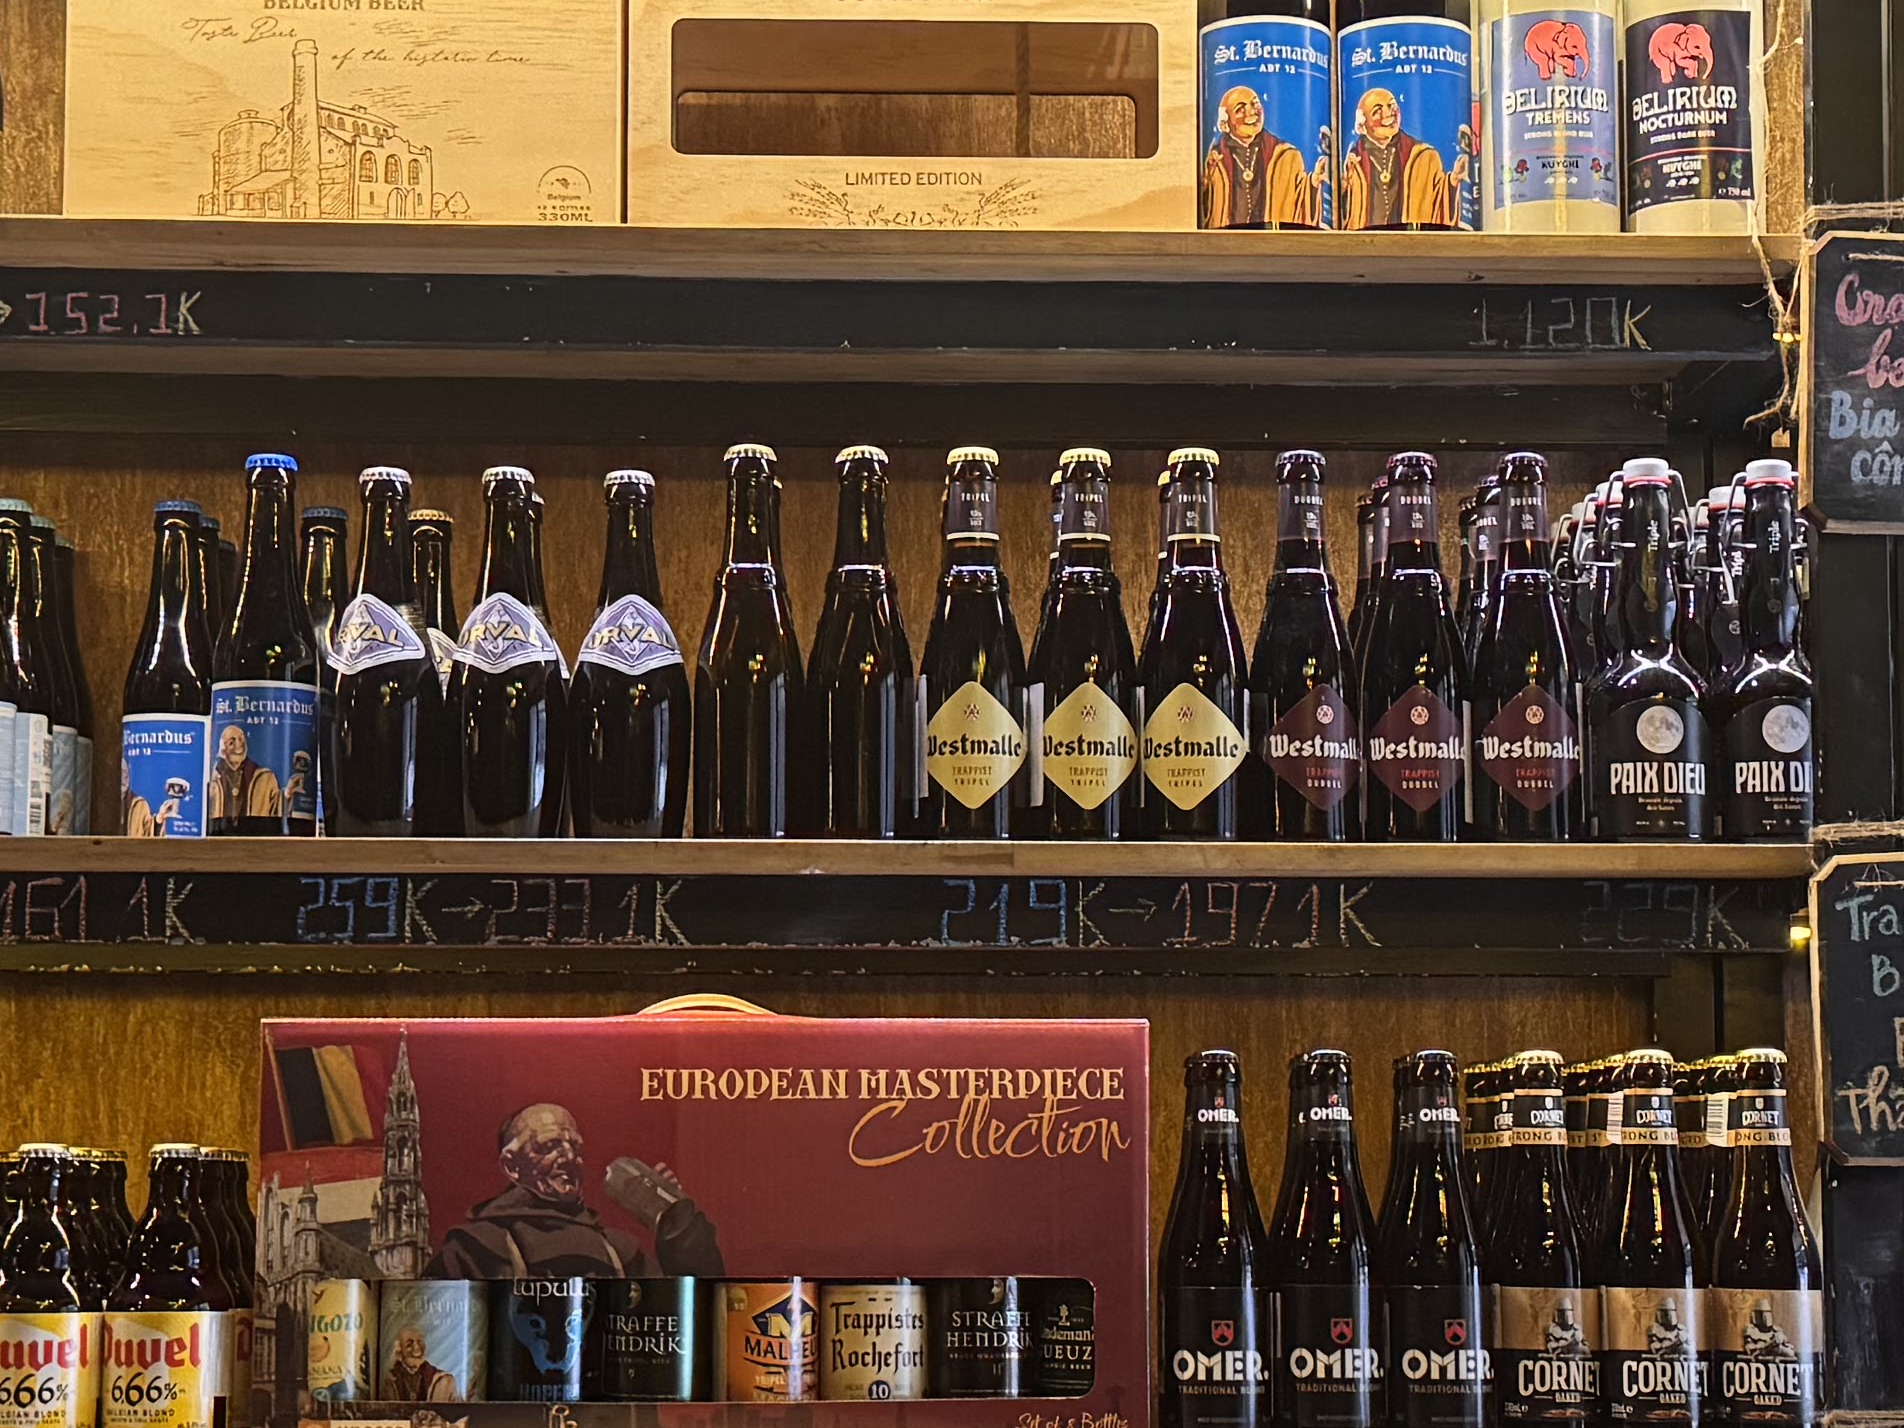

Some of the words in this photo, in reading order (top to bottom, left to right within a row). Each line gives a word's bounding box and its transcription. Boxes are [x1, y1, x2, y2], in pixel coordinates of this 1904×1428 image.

[1503, 86, 1608, 116] DELIRIUM
[1632, 85, 1737, 116] DELIRIUM
[1526, 111, 1591, 127] TREMENS
[1640, 110, 1727, 134] NOCTURNUM
[845, 172, 911, 186] LIMITED
[916, 172, 982, 185] EDITION
[1829, 391, 1901, 442] Bia
[640, 1067, 850, 1101] EUROPEAN
[859, 1067, 1126, 1102] MASTERPIECE
[849, 1097, 1132, 1168] Collection
[1623, 1360, 1709, 1398] CORNET
